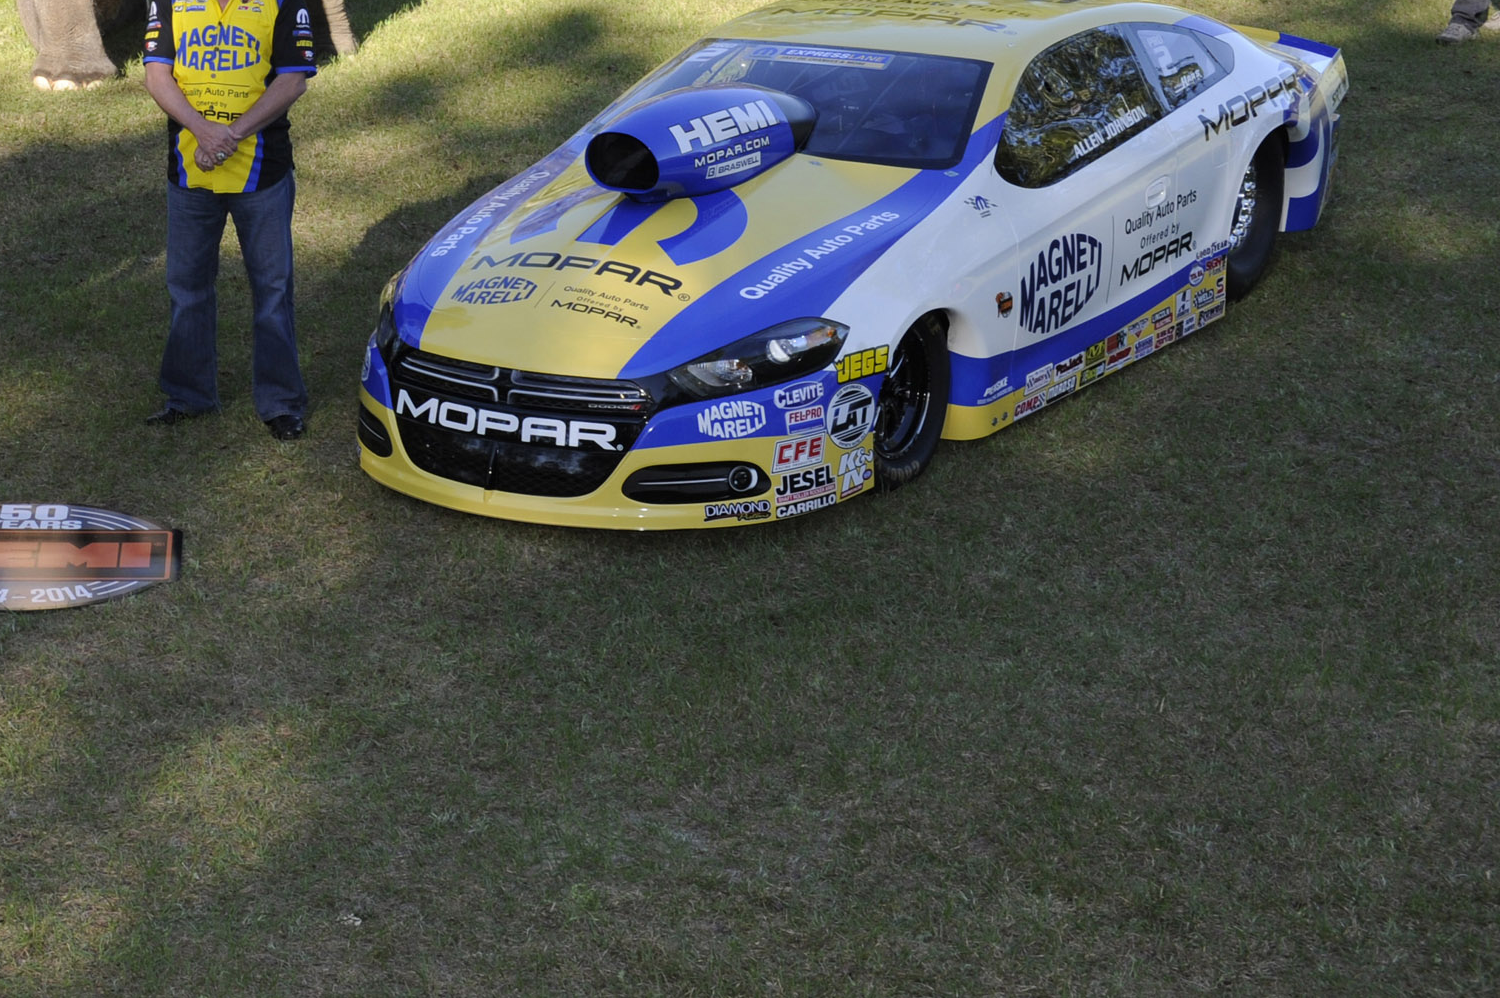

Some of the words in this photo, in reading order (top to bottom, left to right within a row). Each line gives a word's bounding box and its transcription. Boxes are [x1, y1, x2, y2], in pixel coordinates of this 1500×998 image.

[205, 87, 226, 97] Auto
[227, 89, 250, 99] Parts
[668, 100, 780, 154] HEMI
[1073, 132, 1105, 159] ALLEN
[1104, 105, 1148, 140] JOHNSON
[695, 136, 770, 168] MOPAR.COM
[718, 156, 759, 174] BRASWELL
[1125, 210, 1155, 235] Quality
[1156, 201, 1175, 220] Auto
[1176, 189, 1197, 210] Parts
[431, 226, 478, 258] Parts
[1140, 224, 1169, 249] Offered
[1171, 222, 1180, 235] by
[739, 257, 813, 300] Quality
[803, 234, 853, 260] Auto
[843, 211, 900, 236] Parts
[1119, 231, 1192, 286] MOPAR
[472, 251, 684, 298] MOPAR
[564, 285, 597, 297] Quality
[599, 291, 622, 303] Auto
[623, 297, 649, 311] Parts
[551, 299, 639, 329] MOPAR
[837, 344, 890, 384] JEGS
[773, 383, 824, 408] CLEVITE
[396, 388, 618, 451] MOPAR
[788, 407, 822, 424] FEL-PRO
[778, 436, 822, 464] CFE
[775, 465, 836, 496] JESEL
[0, 504, 69, 521] 50
[705, 500, 770, 517] DIAMOND
[776, 493, 837, 518] CARRILLO
[31, 584, 94, 603] 2014
